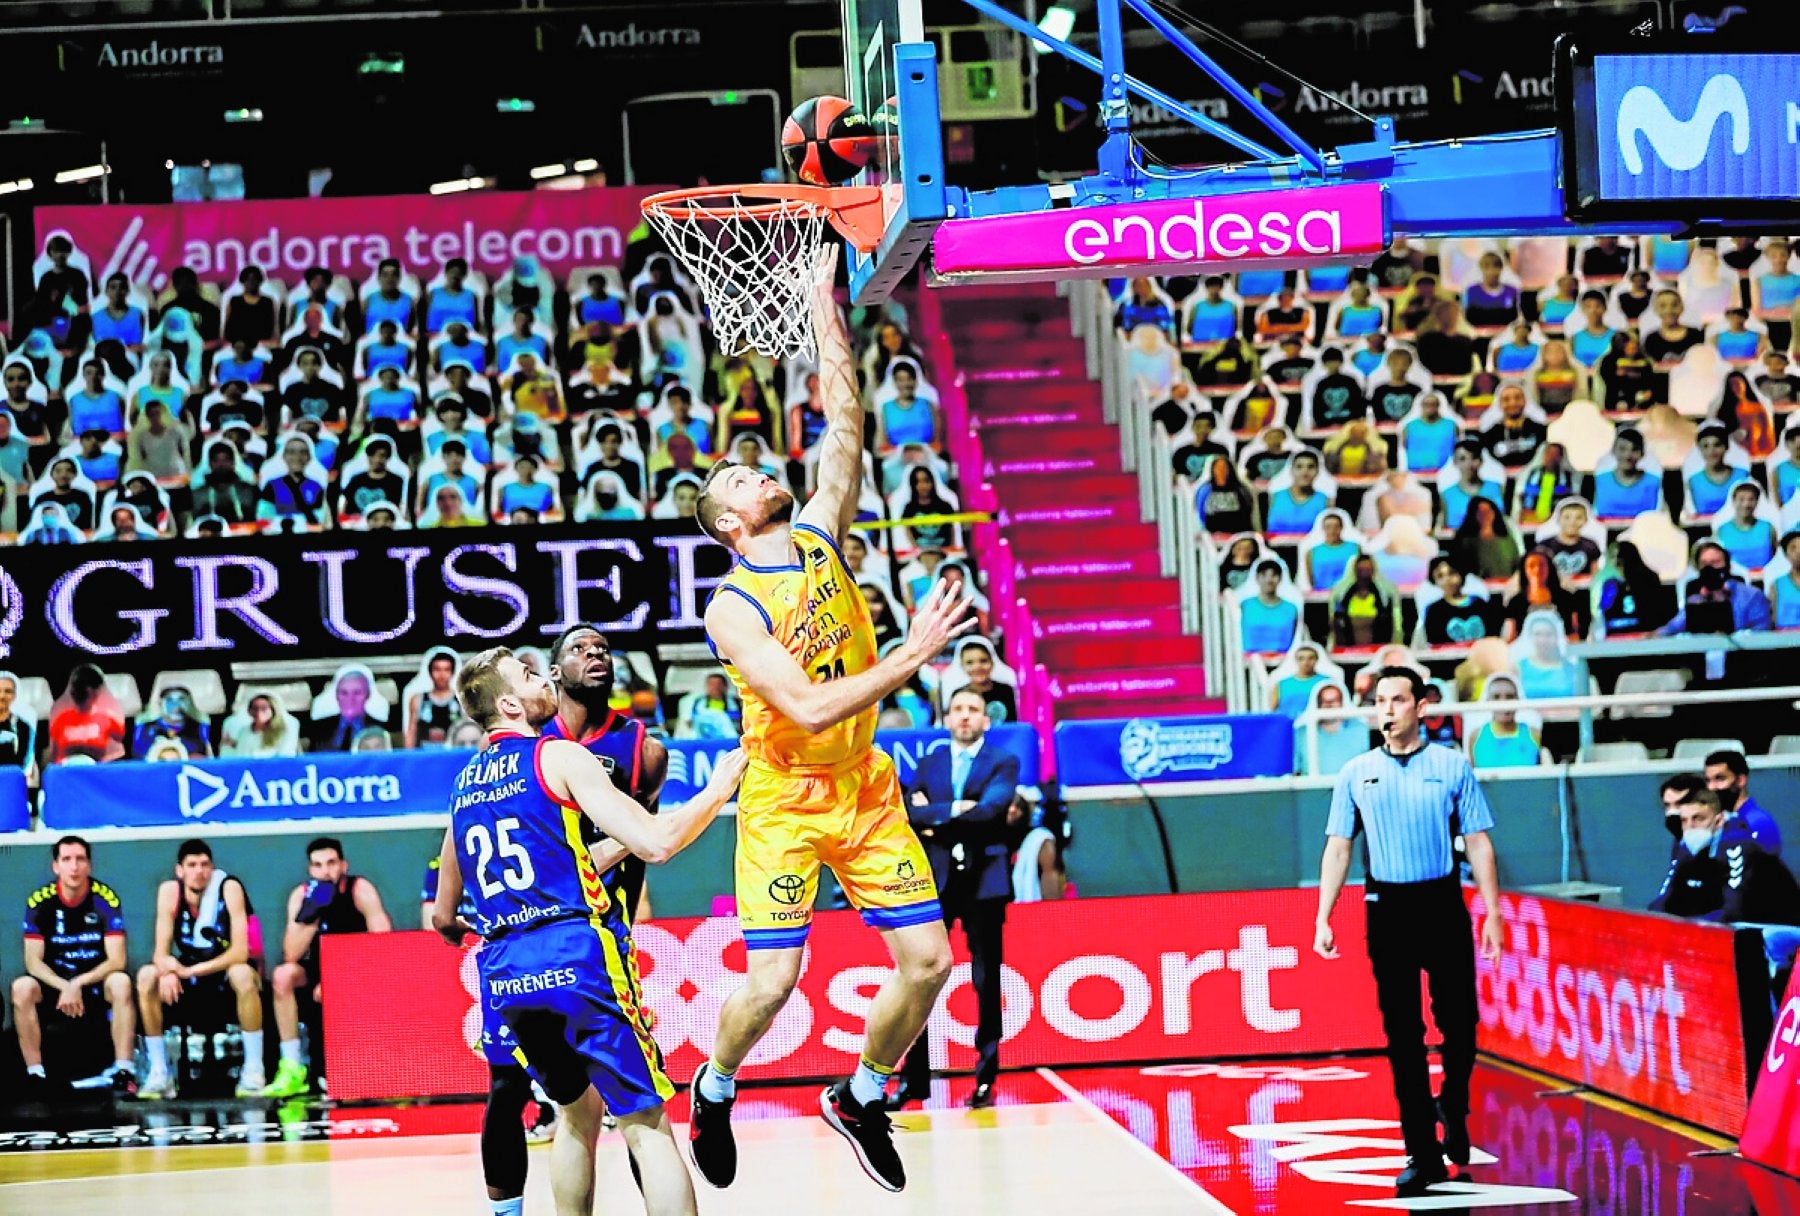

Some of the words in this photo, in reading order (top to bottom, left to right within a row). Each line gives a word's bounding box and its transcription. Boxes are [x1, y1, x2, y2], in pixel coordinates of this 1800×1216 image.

[98, 40, 224, 67] Andorra
[577, 22, 701, 48] Andorra
[1095, 96, 1230, 128] ndorra
[1294, 80, 1429, 114] Andorra
[183, 227, 391, 273] andorra
[404, 221, 623, 266] telecom
[1064, 200, 1341, 263] endesa
[230, 764, 401, 808] Andorra
[465, 817, 536, 901] 25
